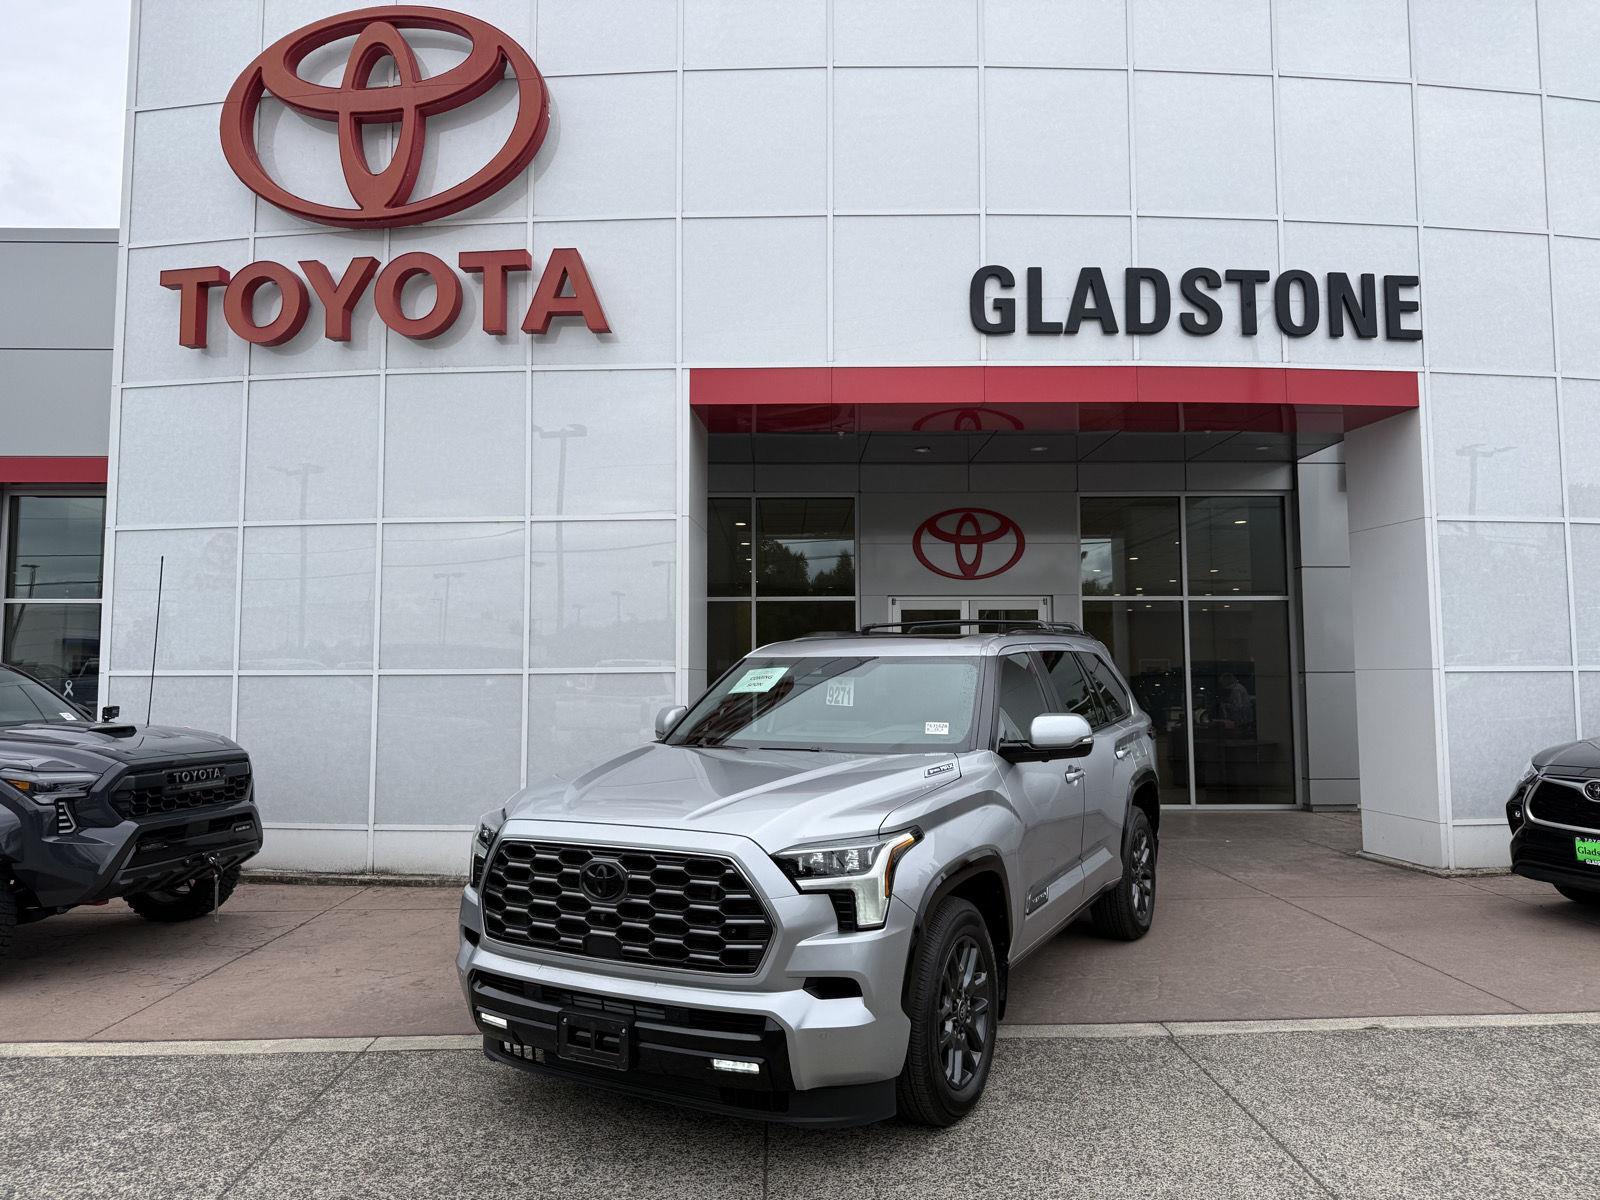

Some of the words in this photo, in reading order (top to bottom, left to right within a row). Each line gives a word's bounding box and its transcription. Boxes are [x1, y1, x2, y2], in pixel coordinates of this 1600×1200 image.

[160, 248, 612, 349] TOYOTA
[969, 265, 1422, 341] GLADSTONE
[827, 686, 851, 705] 9271
[173, 767, 221, 783] TOYOTA
